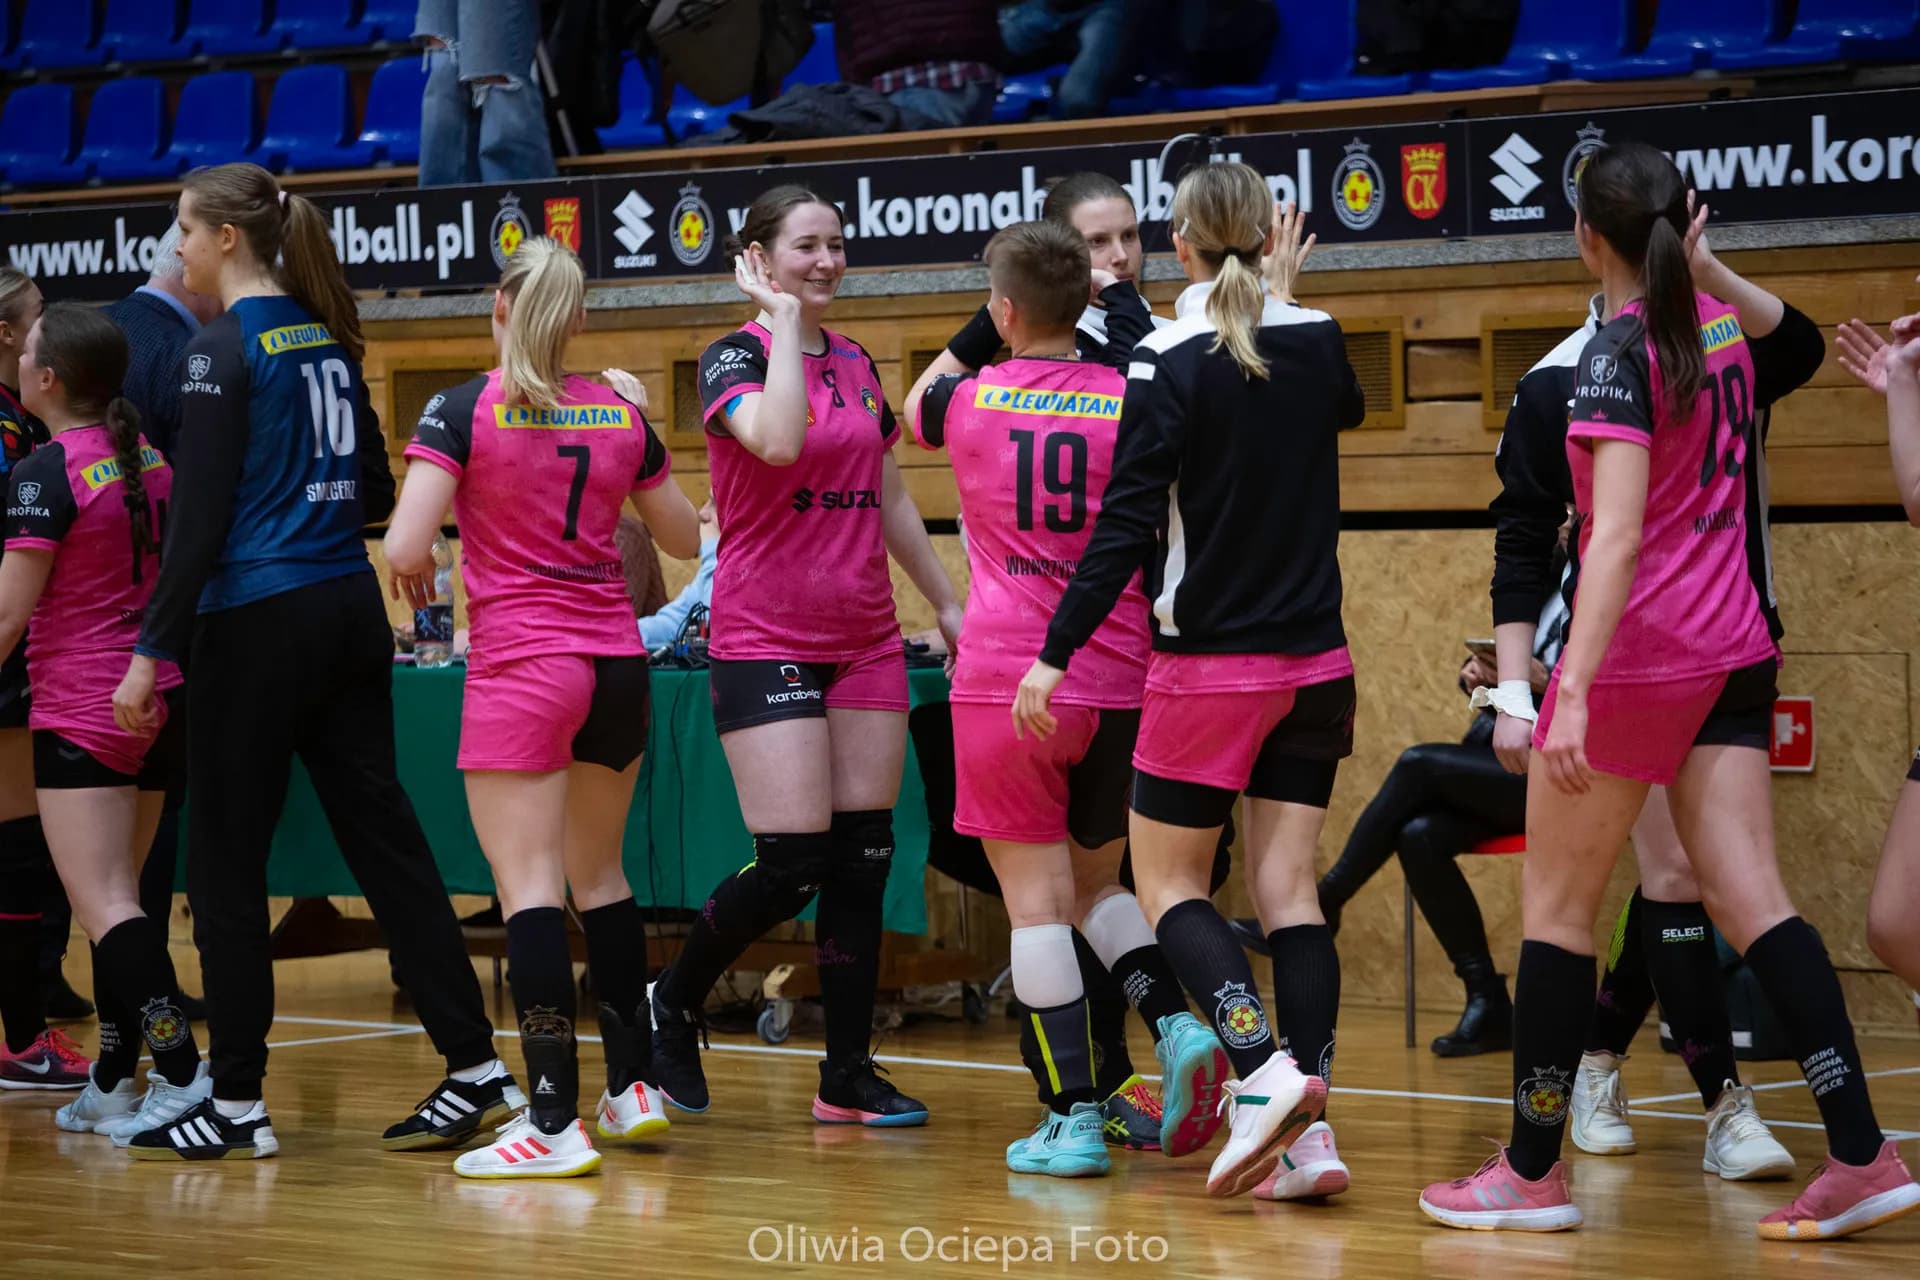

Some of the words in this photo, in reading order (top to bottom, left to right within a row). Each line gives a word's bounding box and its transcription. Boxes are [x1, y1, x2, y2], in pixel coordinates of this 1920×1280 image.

[1406, 173, 1440, 211] CK
[1489, 206, 1546, 222] SUZUKI
[614, 253, 657, 269] SUZUKI
[288, 326, 331, 346] LEWIA
[706, 363, 747, 386] Horizon
[300, 358, 356, 458] 16
[1011, 391, 1120, 416] LEWIATAN
[531, 408, 623, 425] LEWIATAN
[1009, 429, 1088, 533] 19
[557, 445, 590, 541] 7
[821, 490, 881, 510] SUZU
[1662, 926, 1705, 939] SELECT
